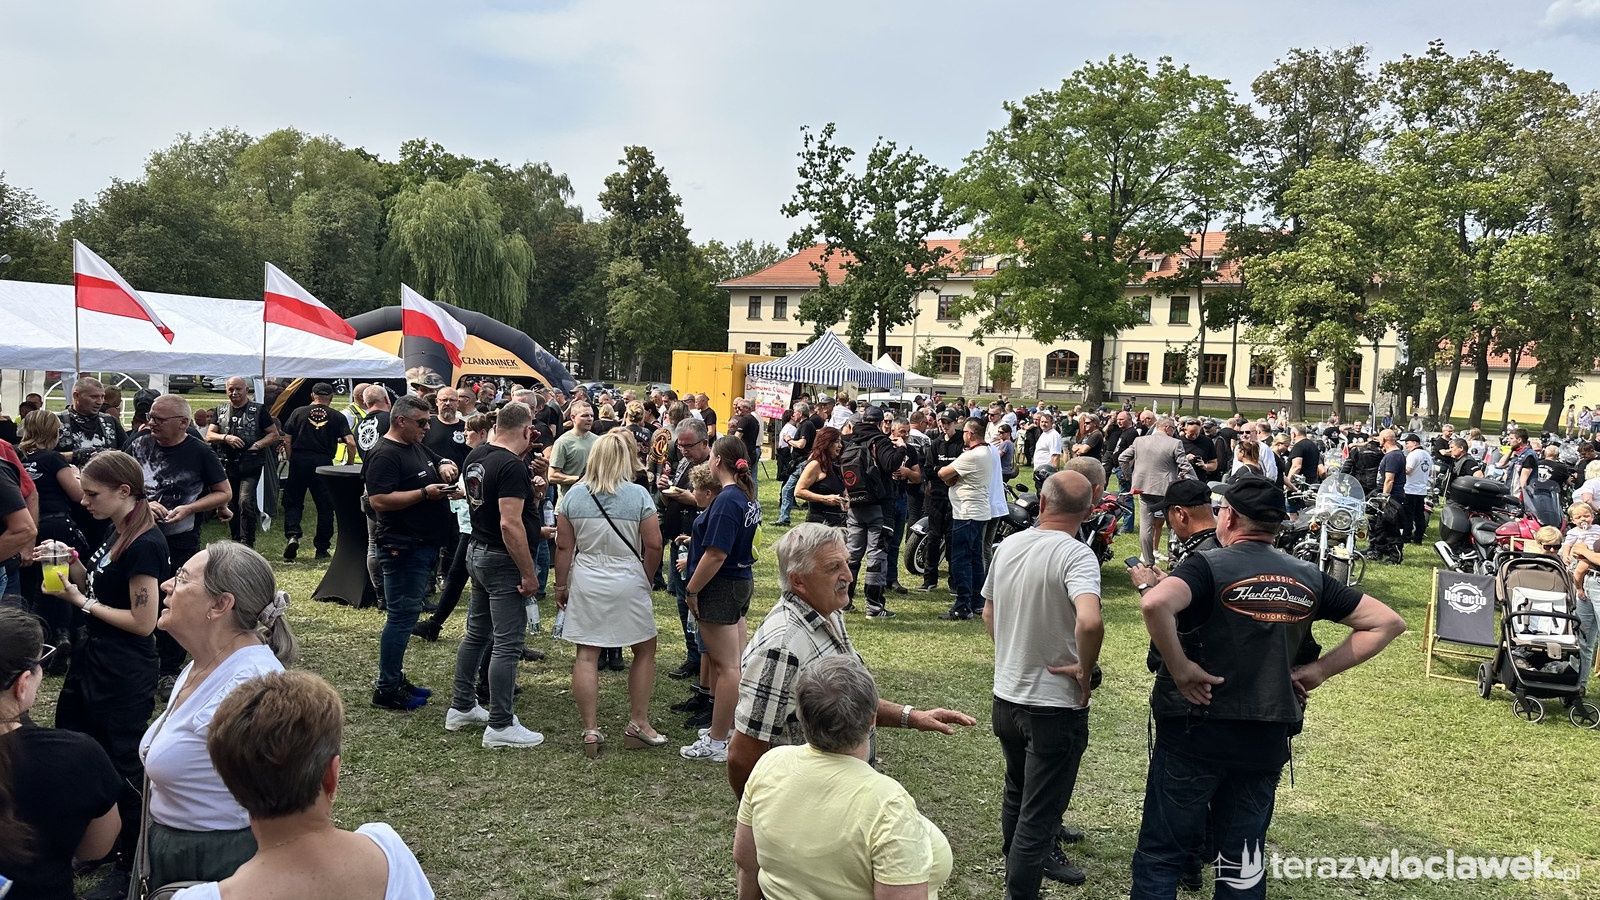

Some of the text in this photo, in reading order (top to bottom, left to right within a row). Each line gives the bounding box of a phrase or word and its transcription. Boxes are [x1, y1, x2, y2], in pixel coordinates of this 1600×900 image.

[461, 356, 518, 366] CZAMANINEK
[1259, 575, 1294, 584] CLASSIC
[1229, 586, 1314, 608] Harley-Davidson
[1444, 589, 1487, 606] DeFacto
